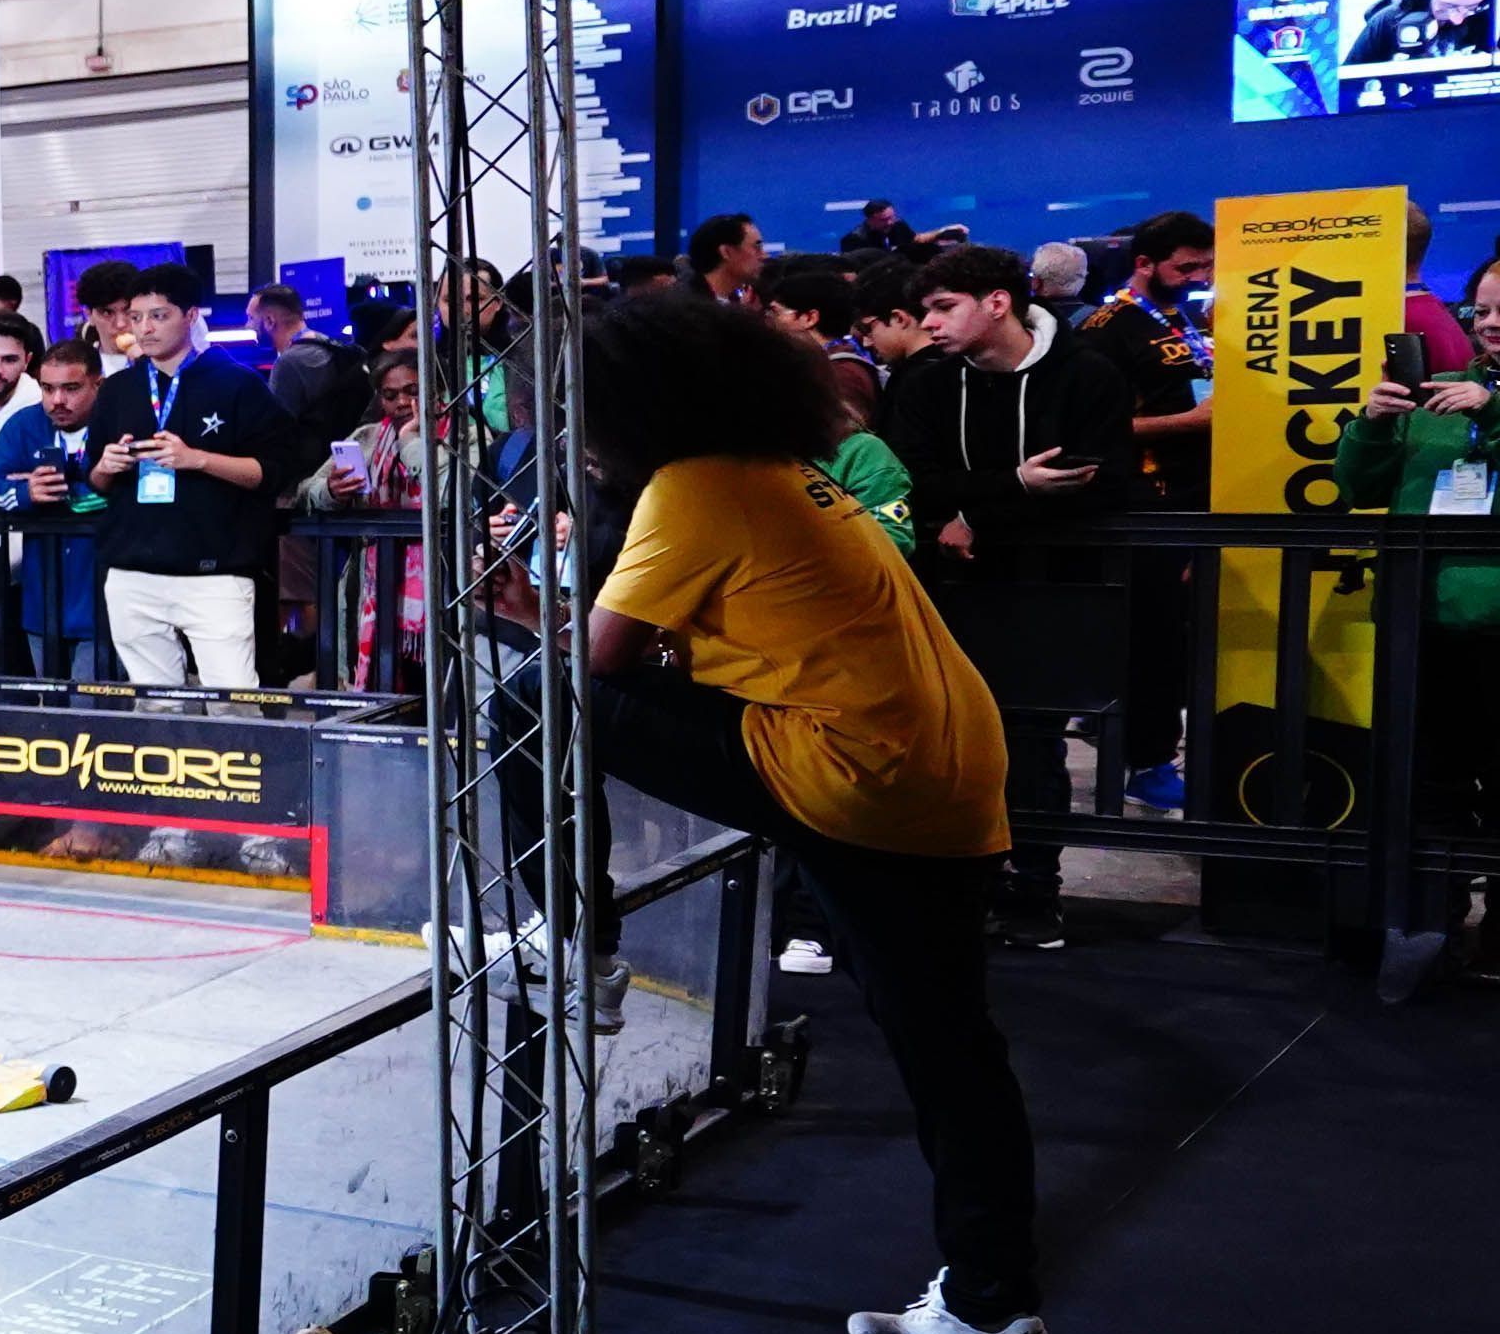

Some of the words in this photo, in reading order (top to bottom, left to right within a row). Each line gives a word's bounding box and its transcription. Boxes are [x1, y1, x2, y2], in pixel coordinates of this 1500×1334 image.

[787, 2, 863, 30] Brazil
[866, 3, 897, 31] pc
[323, 89, 370, 101] PAULO
[787, 87, 854, 114] GPJ
[912, 93, 1021, 119] TRONOS
[1079, 89, 1134, 106] ZOWIE
[1241, 230, 1381, 245] www.robocore.net
[1246, 267, 1280, 375] ARENA
[1284, 267, 1363, 571] OCKEY
[97, 781, 261, 804] www.robocore.net
